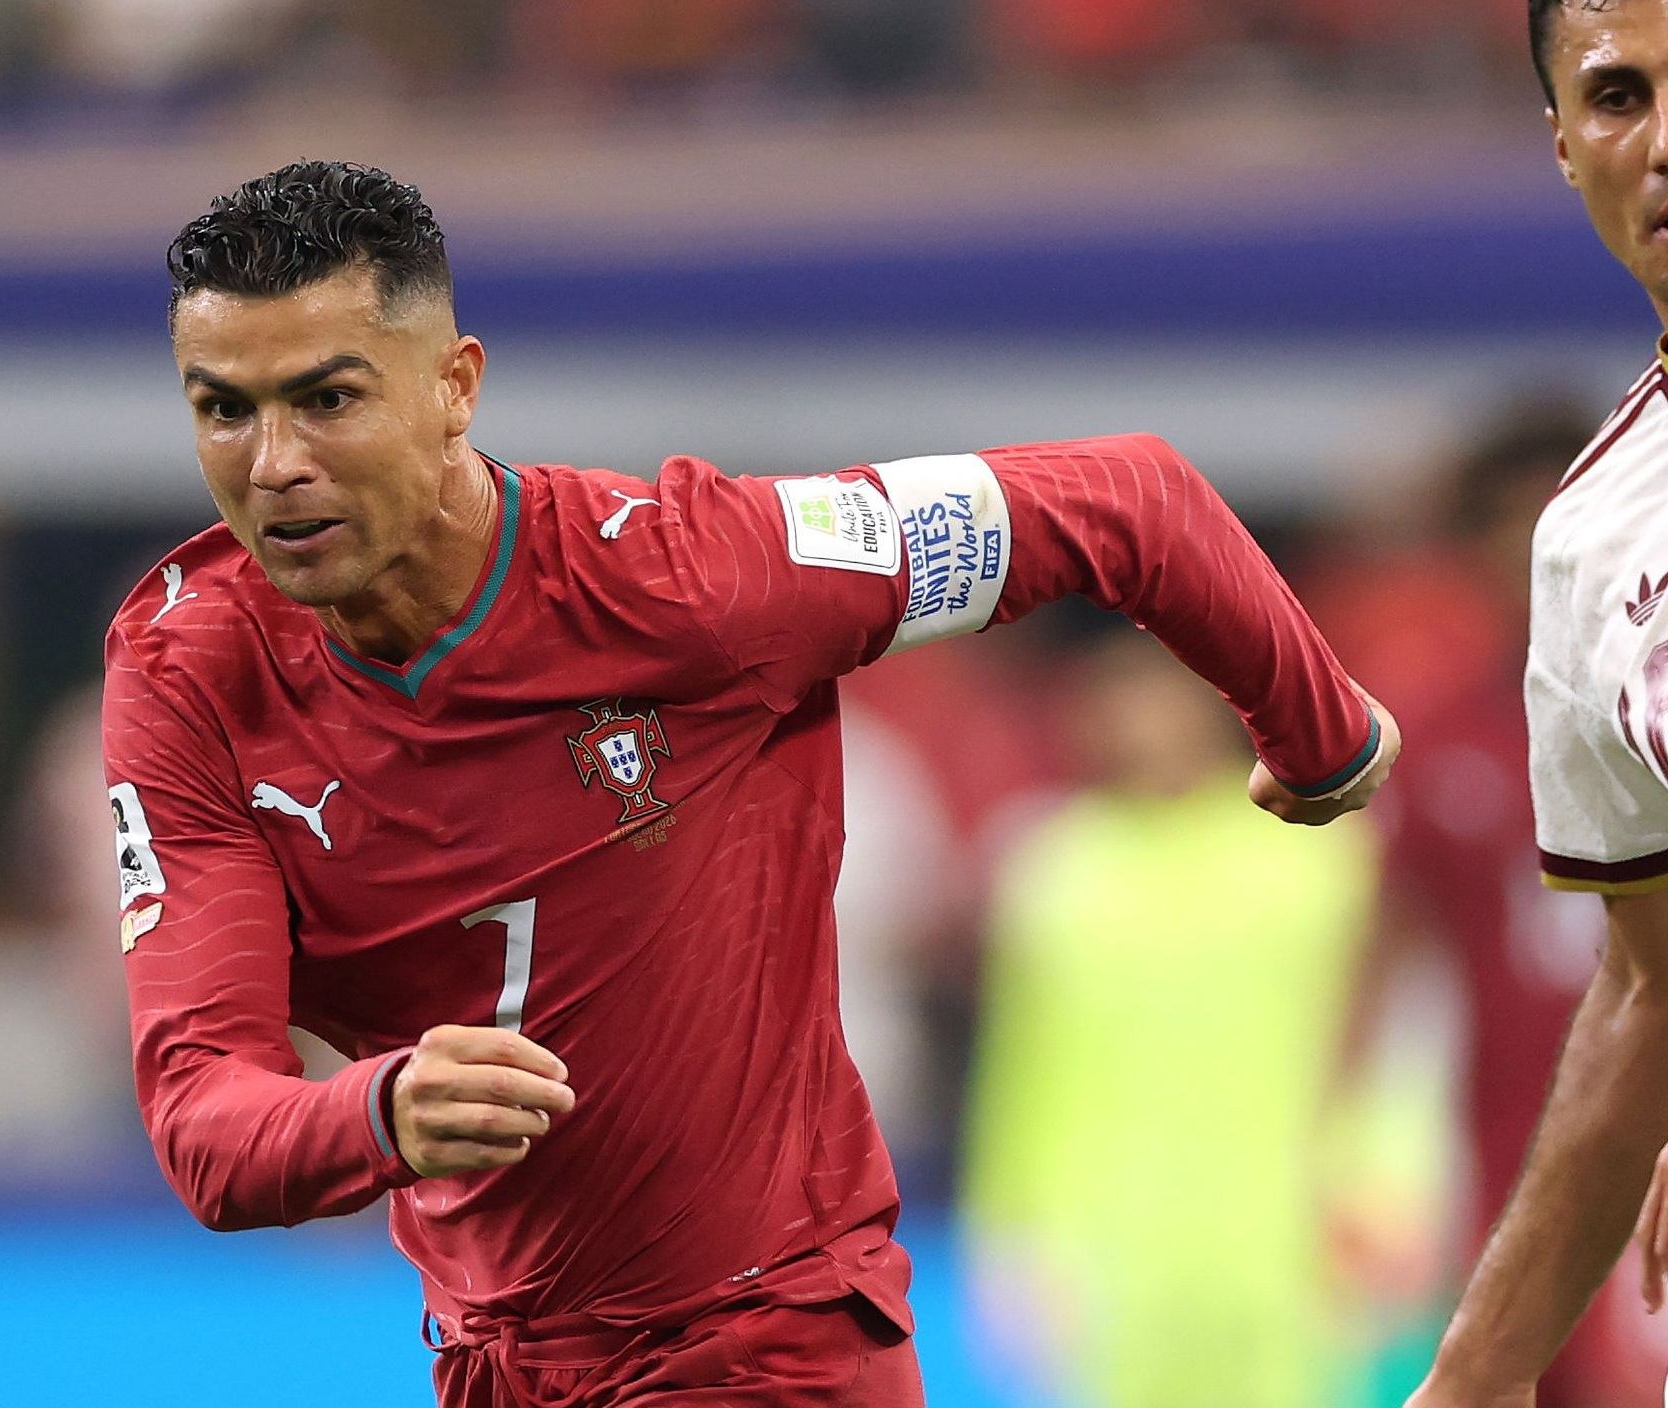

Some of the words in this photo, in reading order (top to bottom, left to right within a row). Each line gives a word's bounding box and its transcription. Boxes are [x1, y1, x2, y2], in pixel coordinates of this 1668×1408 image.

[901, 508, 926, 624] FOOTBALL
[917, 501, 951, 618] UNITES
[944, 492, 979, 574] World
[983, 532, 1000, 577] FIFA
[947, 576, 972, 615] the
